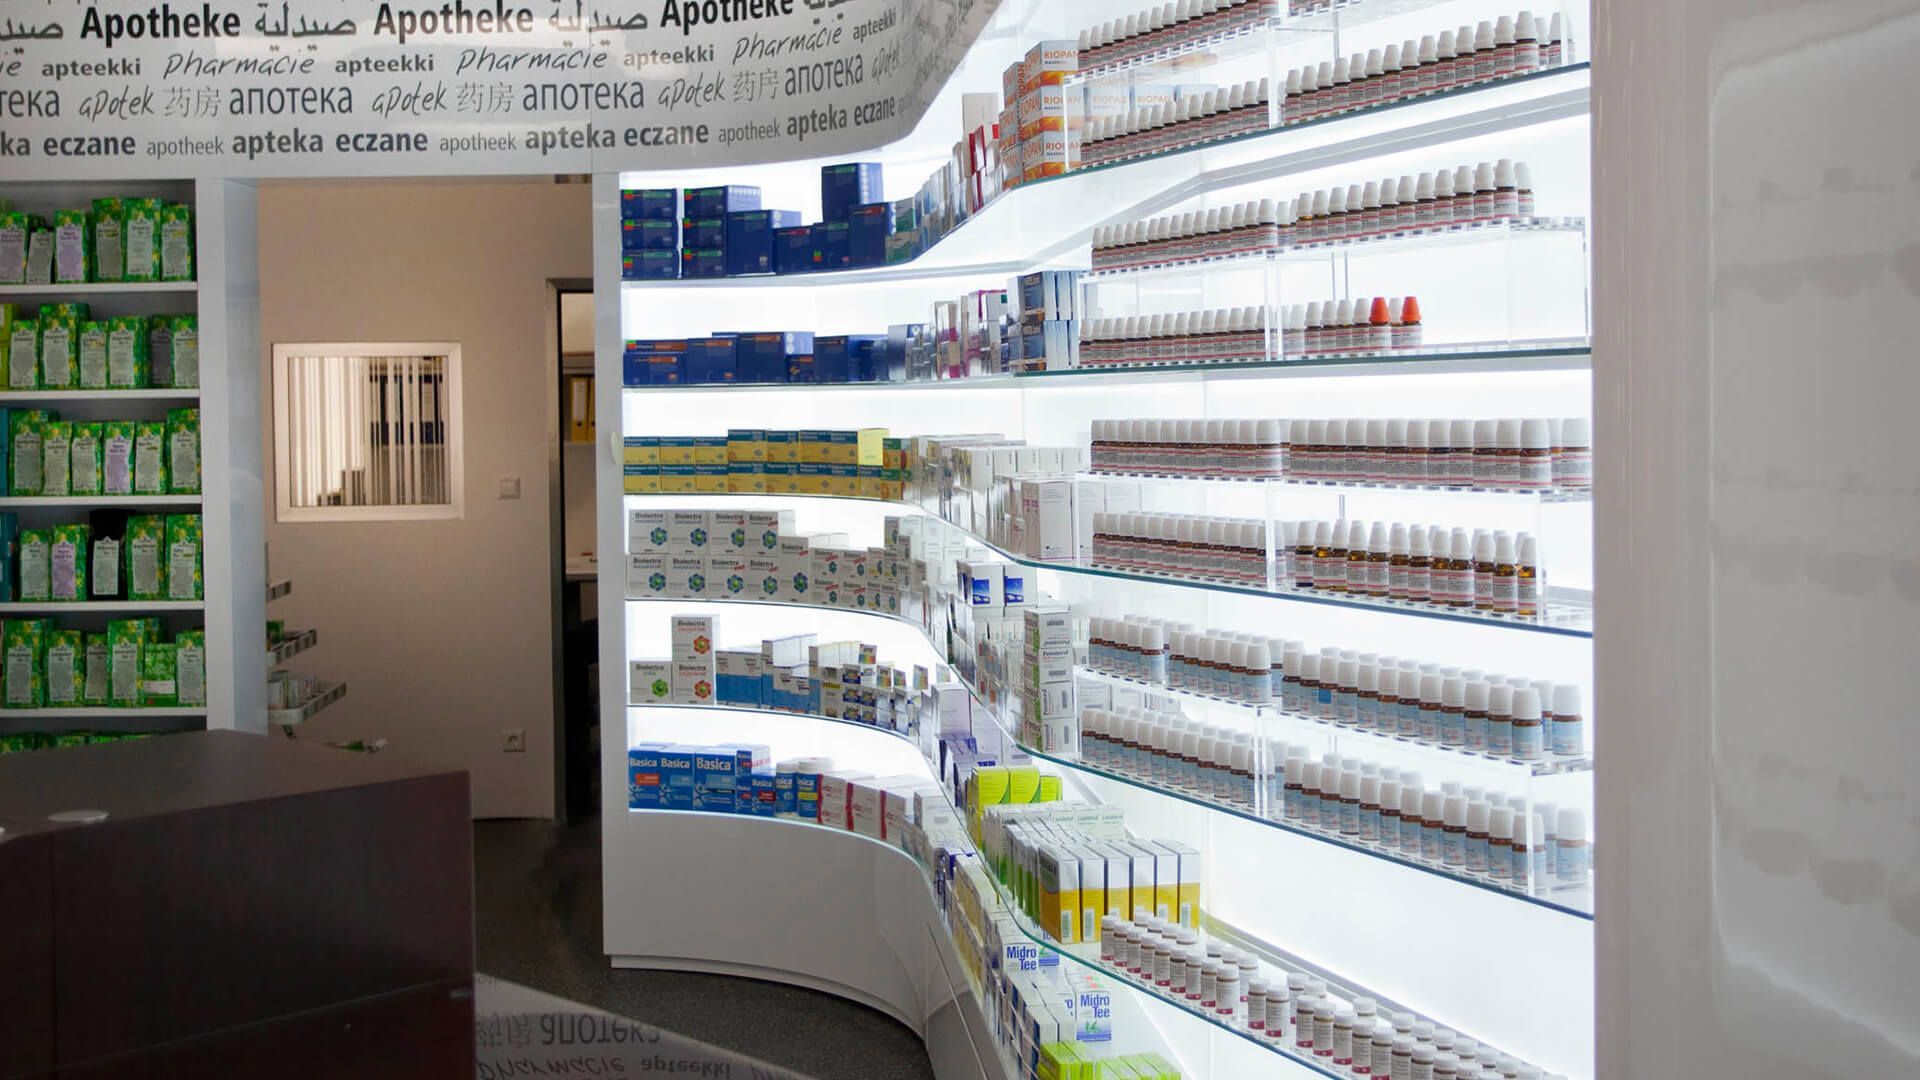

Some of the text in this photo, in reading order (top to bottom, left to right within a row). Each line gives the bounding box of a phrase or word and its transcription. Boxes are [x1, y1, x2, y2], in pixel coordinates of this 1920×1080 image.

[80, 4, 241, 48] Apotheke
[255, 2, 356, 51] صيدلية
[374, 0, 534, 44] Apotheke
[549, 0, 647, 47] صيدلية
[42, 58, 141, 80] apteekki
[335, 54, 434, 77] apteekki
[624, 44, 714, 70] apteekki
[853, 6, 896, 43] apteekki
[79, 84, 155, 122] apotek
[163, 86, 221, 118] 药房
[229, 86, 352, 115] апотека
[372, 80, 448, 118] apotek
[456, 81, 515, 113] 药房
[523, 81, 643, 111] апотека
[658, 72, 726, 111] apotek
[733, 68, 780, 102] 药房
[785, 53, 863, 96] апотека
[44, 136, 135, 156] eczane
[147, 136, 224, 160] apotheek
[232, 127, 323, 160] apteka
[336, 132, 428, 152] eczane
[439, 131, 517, 155] apotheek
[526, 123, 615, 155] apteka
[624, 123, 708, 146] eczane
[718, 118, 780, 147] apotheek
[787, 103, 847, 141] apteka
[854, 96, 895, 127] eczane
[630, 757, 657, 767] Basica
[661, 758, 690, 768] Basica
[696, 757, 731, 771] Basica
[1007, 945, 1037, 958] Midro
[1019, 958, 1037, 970] Tee
[1080, 993, 1110, 1006] Midro
[1092, 1006, 1110, 1018] Tee
